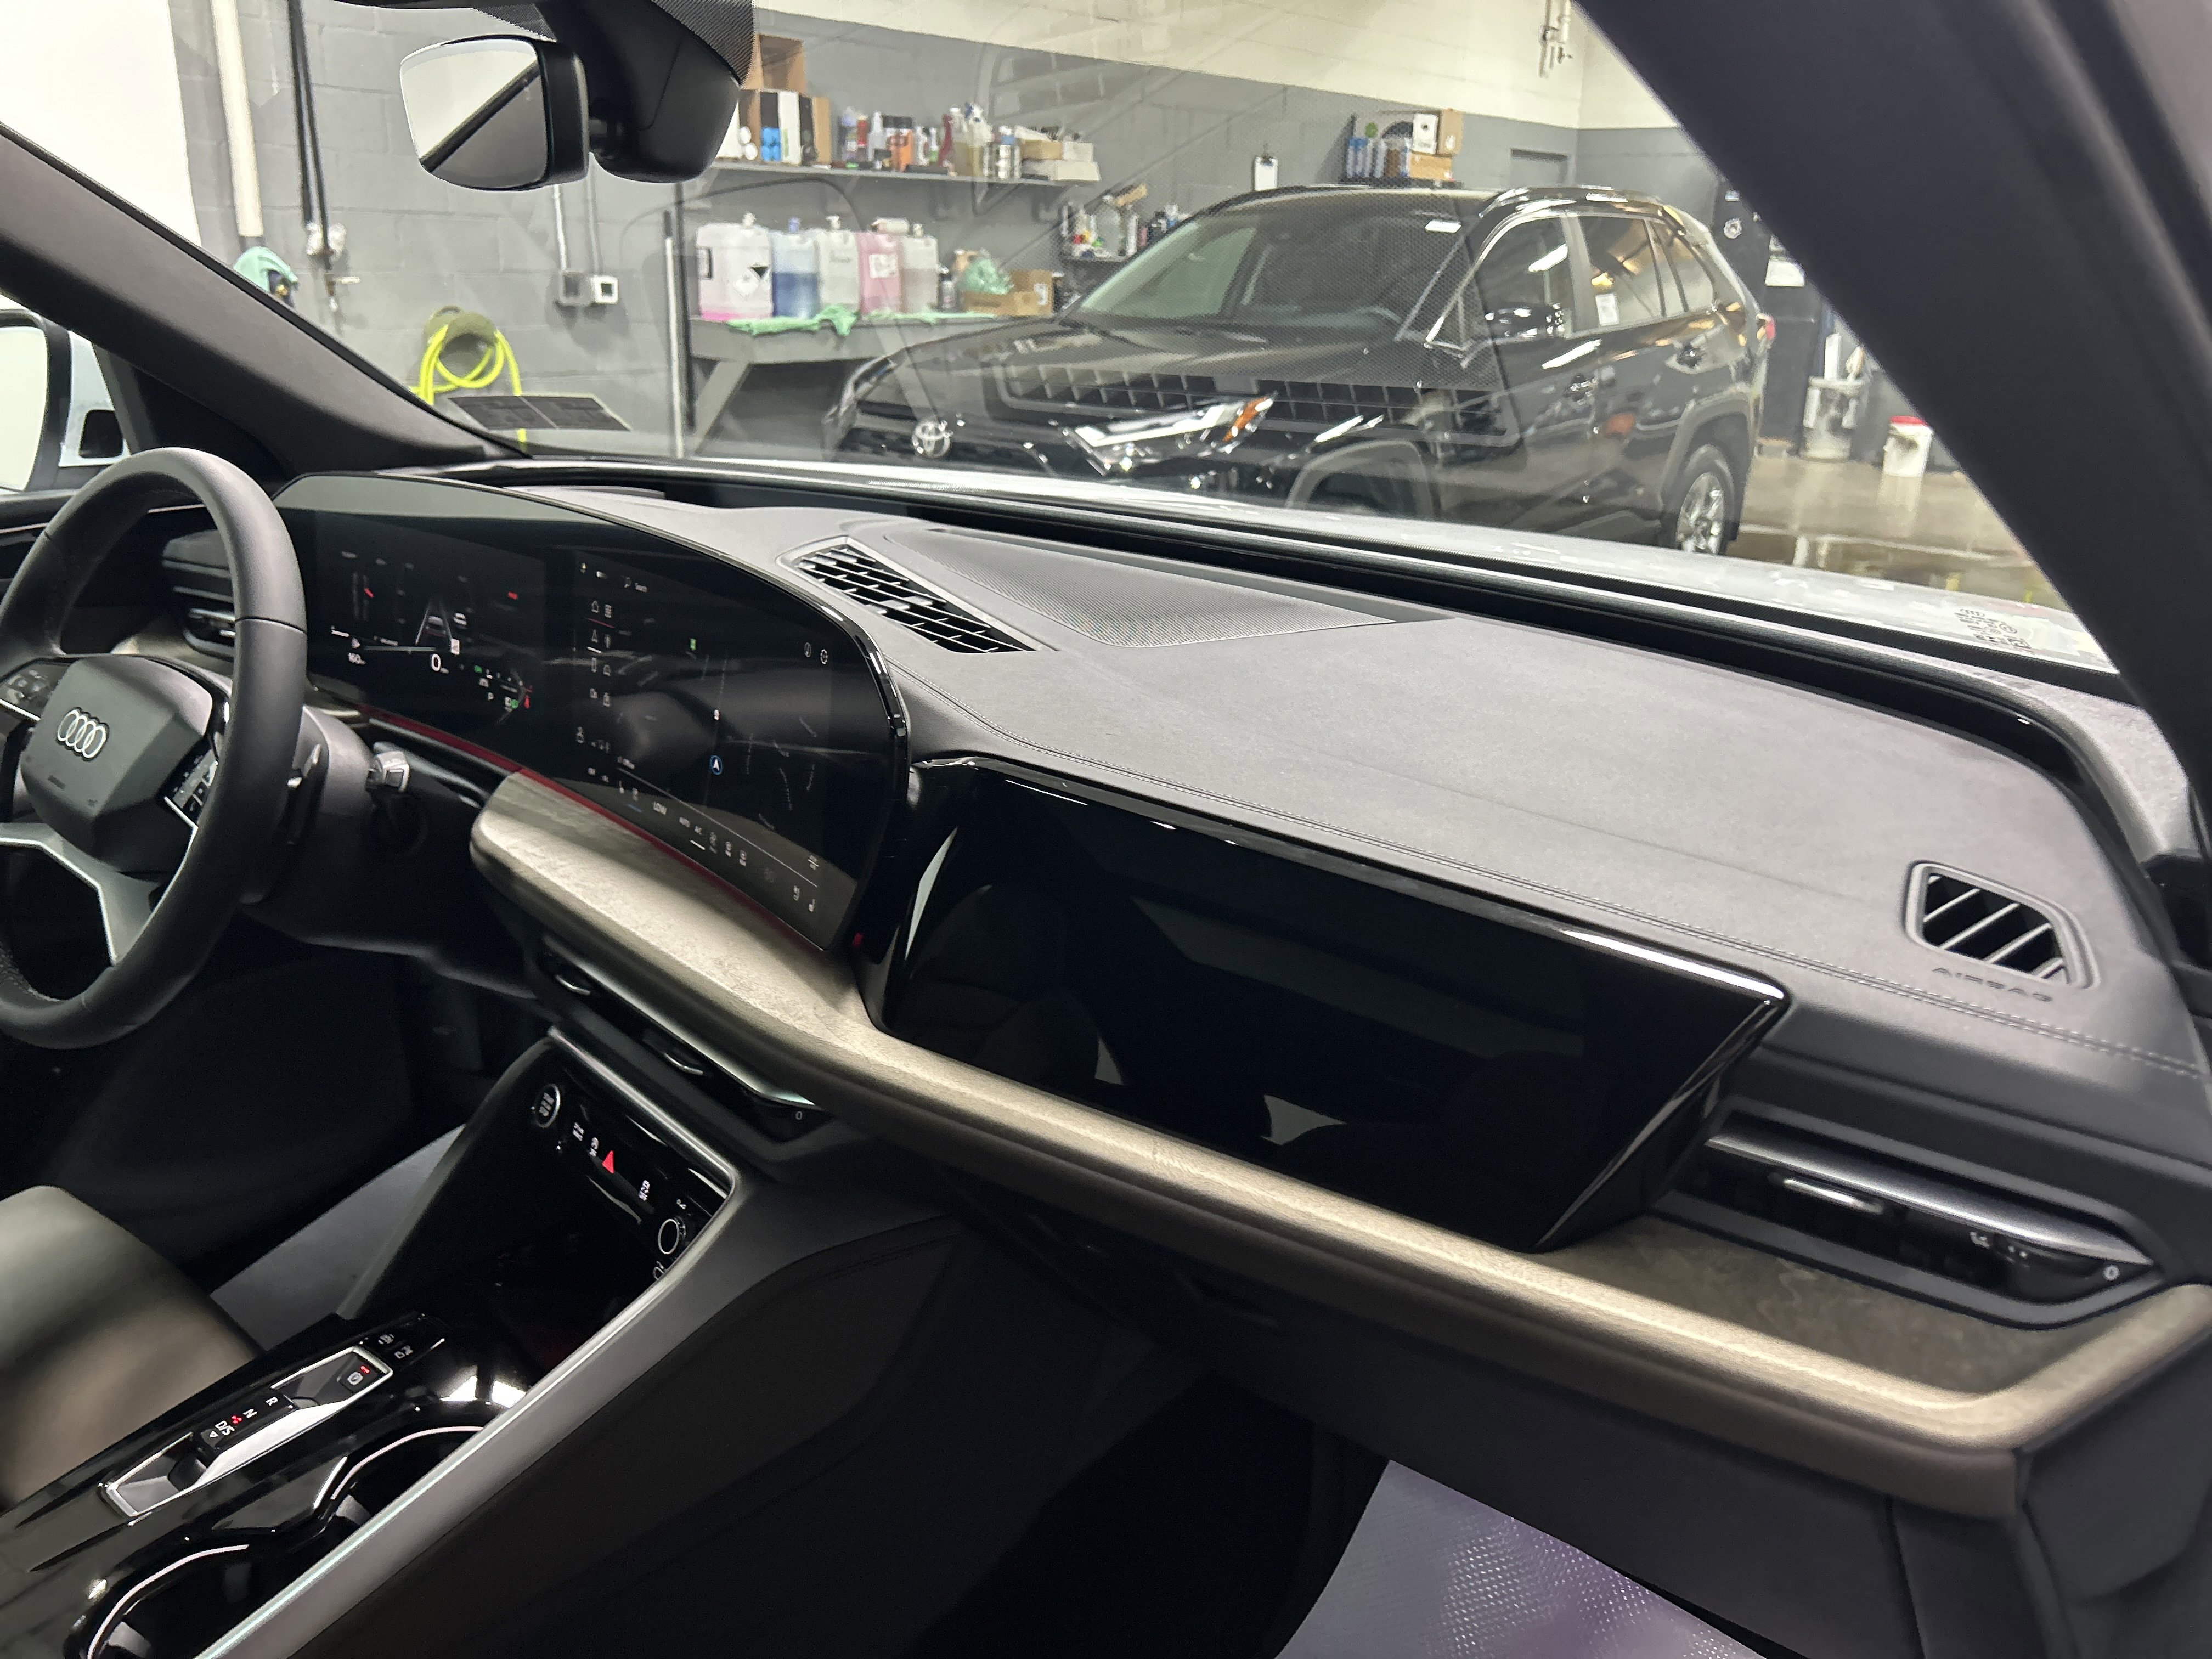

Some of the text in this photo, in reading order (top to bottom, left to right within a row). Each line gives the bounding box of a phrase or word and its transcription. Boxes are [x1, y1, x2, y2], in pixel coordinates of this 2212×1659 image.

[431, 653, 441, 672] 0
[266, 1396, 278, 1407] R
[243, 1408, 257, 1418] N
[215, 1420, 235, 1436] D/S
